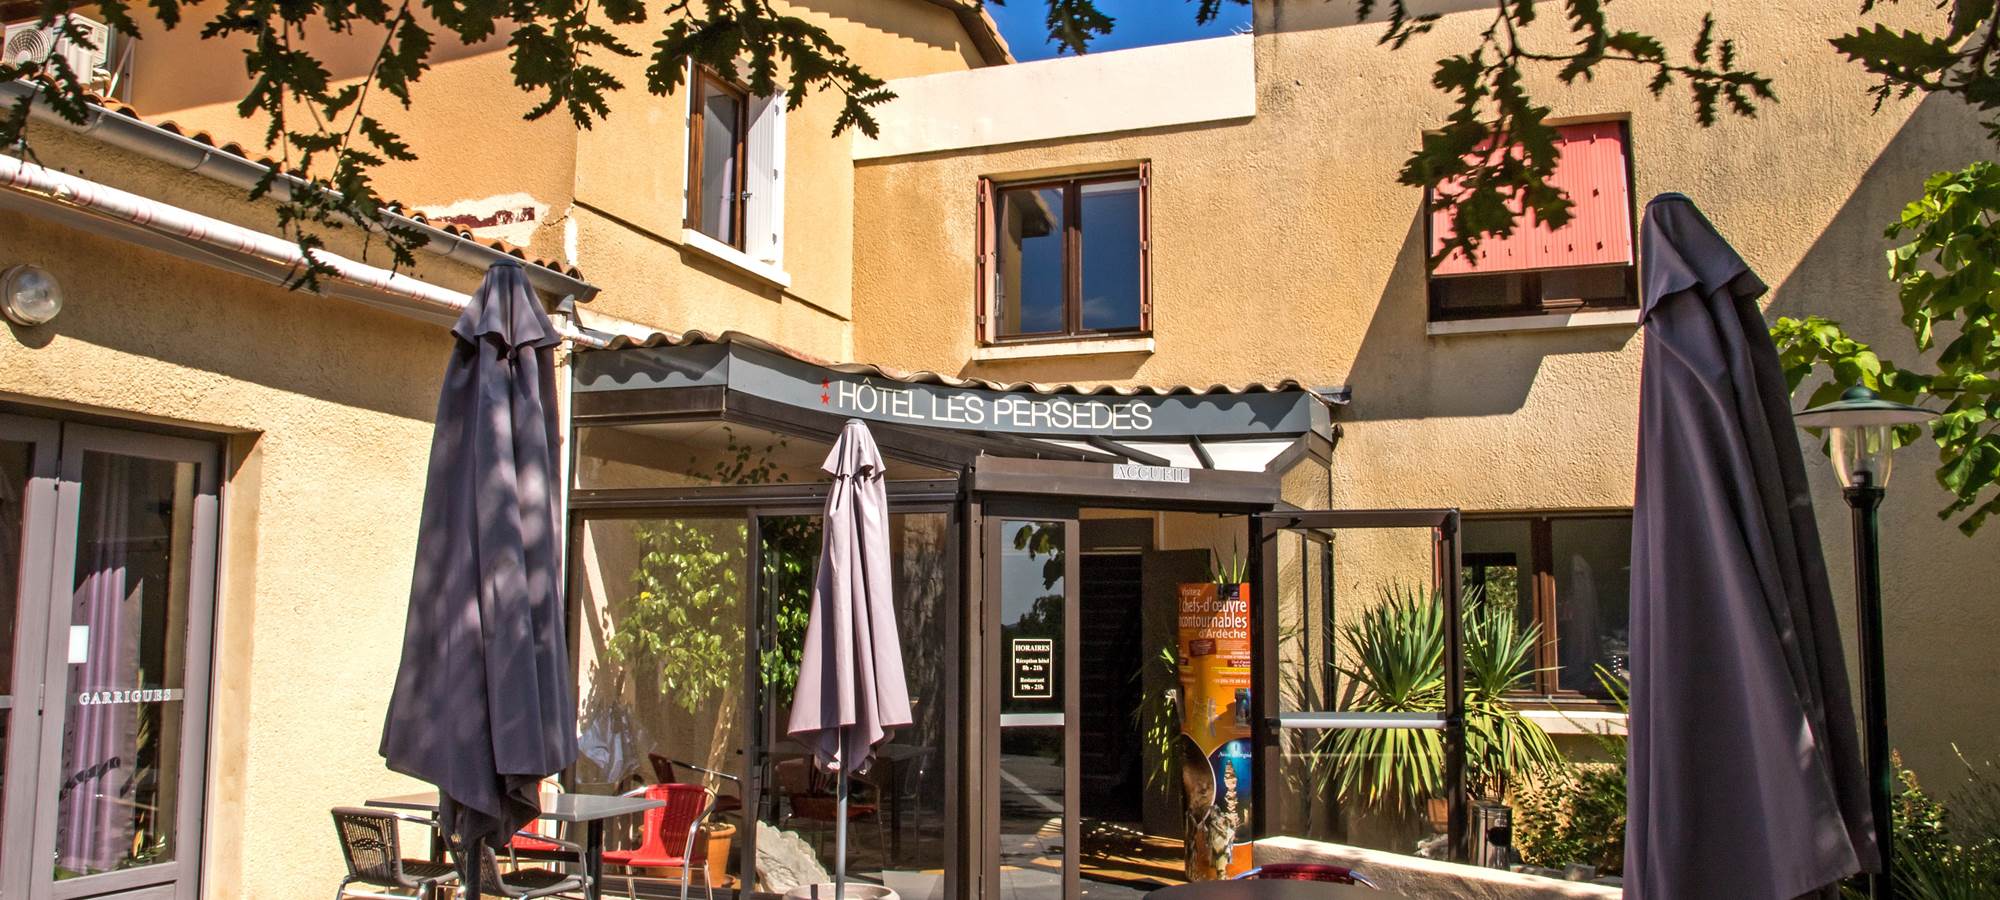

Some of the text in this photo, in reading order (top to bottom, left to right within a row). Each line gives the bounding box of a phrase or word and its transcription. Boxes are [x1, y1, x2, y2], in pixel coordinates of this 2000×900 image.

[839, 377, 1153, 430] HÔTEL LES PERSEDES
[1118, 464, 1188, 482] ACCUEIL
[1199, 629, 1247, 639] d'Ardèche
[1015, 644, 1050, 652] HORAIRES
[79, 688, 171, 705] GARRIGUES
